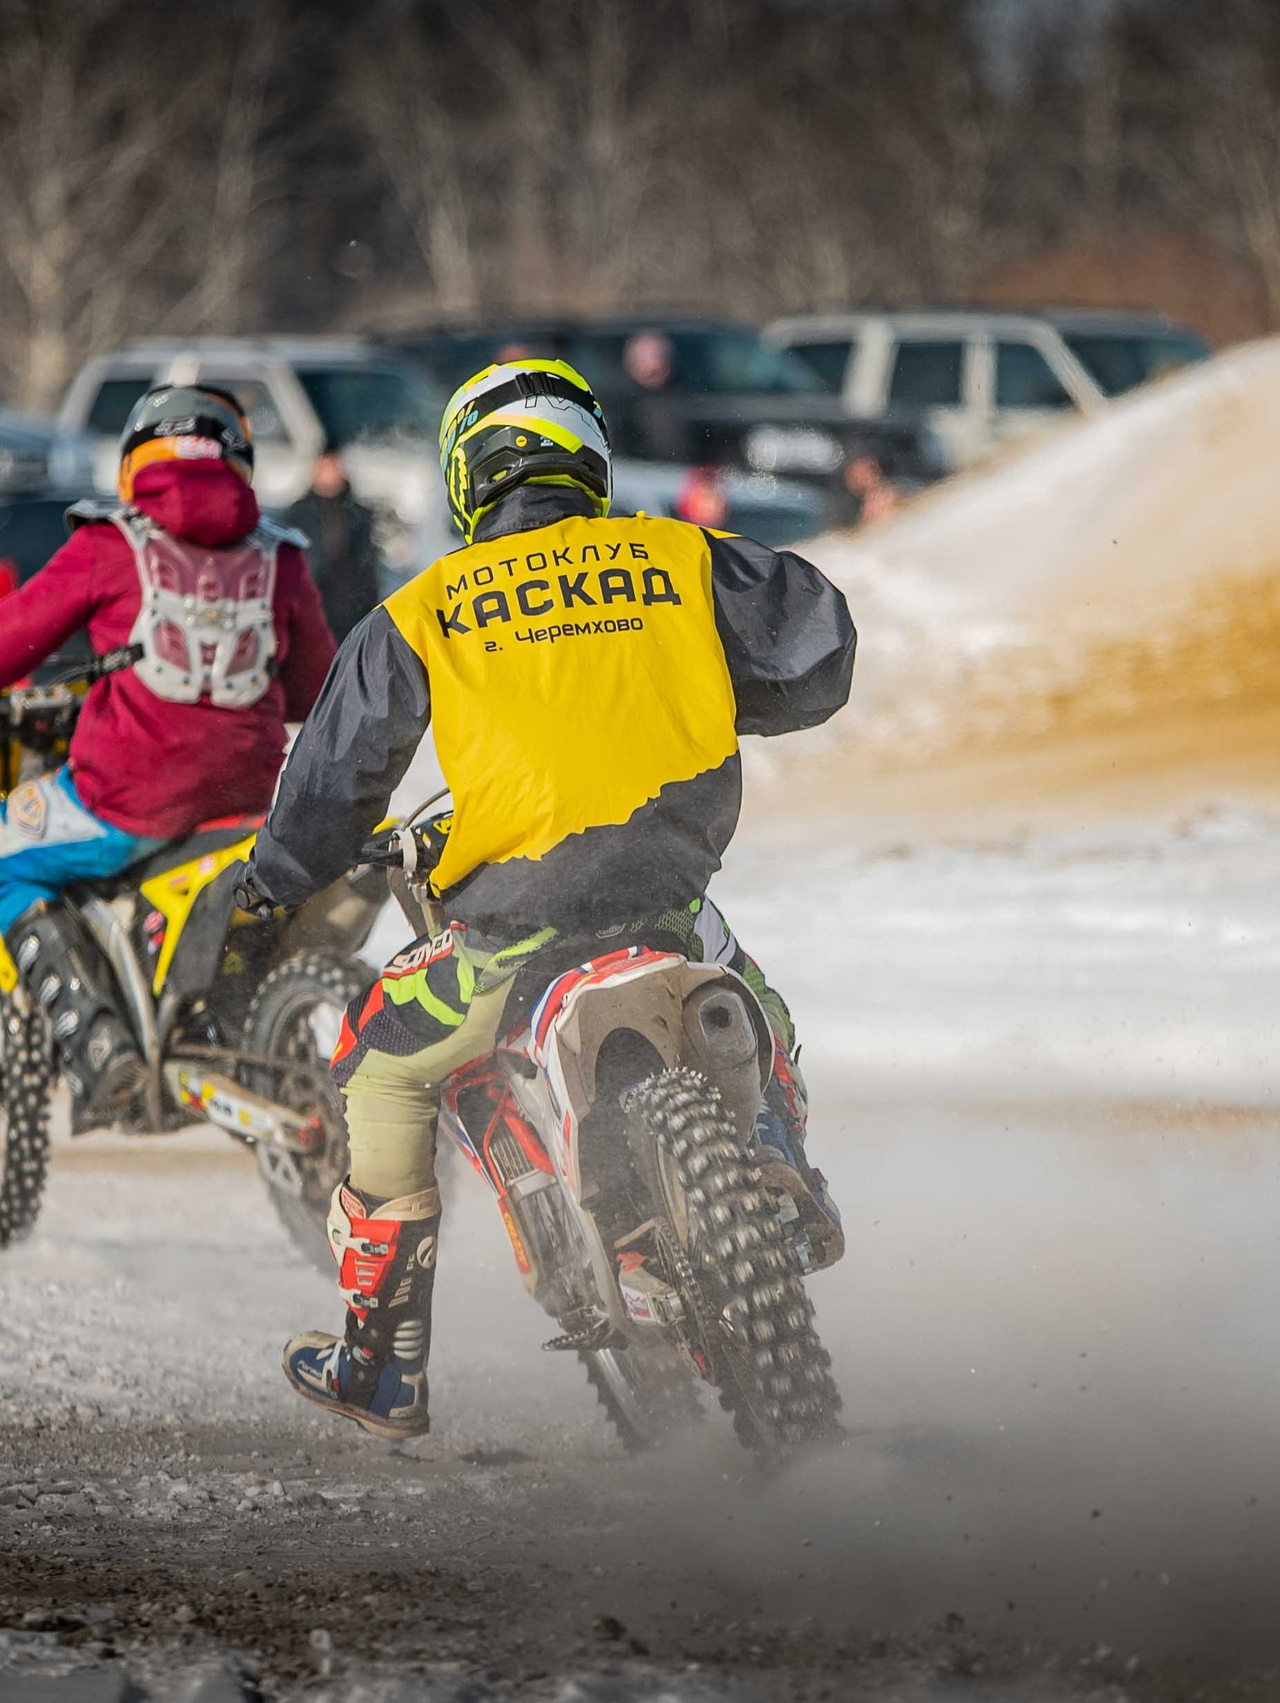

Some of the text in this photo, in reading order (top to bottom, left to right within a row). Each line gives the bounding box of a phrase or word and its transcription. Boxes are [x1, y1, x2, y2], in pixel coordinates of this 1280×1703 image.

[445, 542, 650, 600] МОТОКЛУБ
[435, 567, 682, 639] КАСКАД
[514, 617, 644, 644] Черемхово
